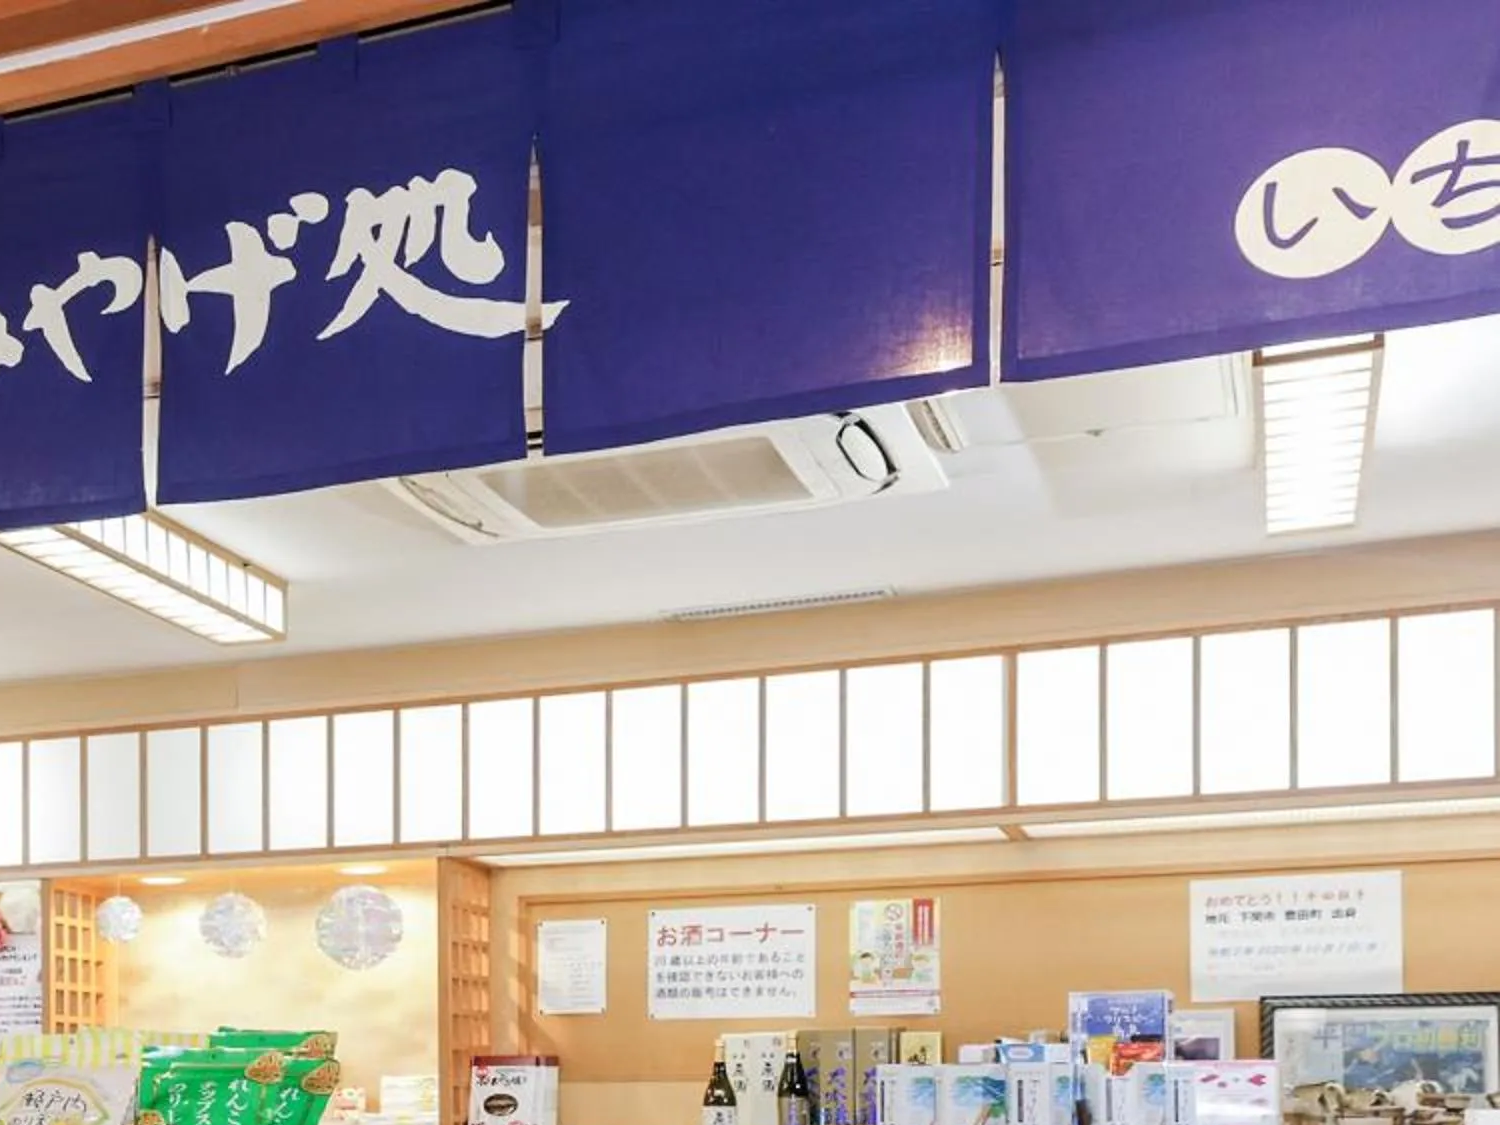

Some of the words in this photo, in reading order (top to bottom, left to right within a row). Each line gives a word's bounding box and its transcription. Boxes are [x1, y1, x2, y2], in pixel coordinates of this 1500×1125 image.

[657, 922, 805, 947] お酒コーナー
